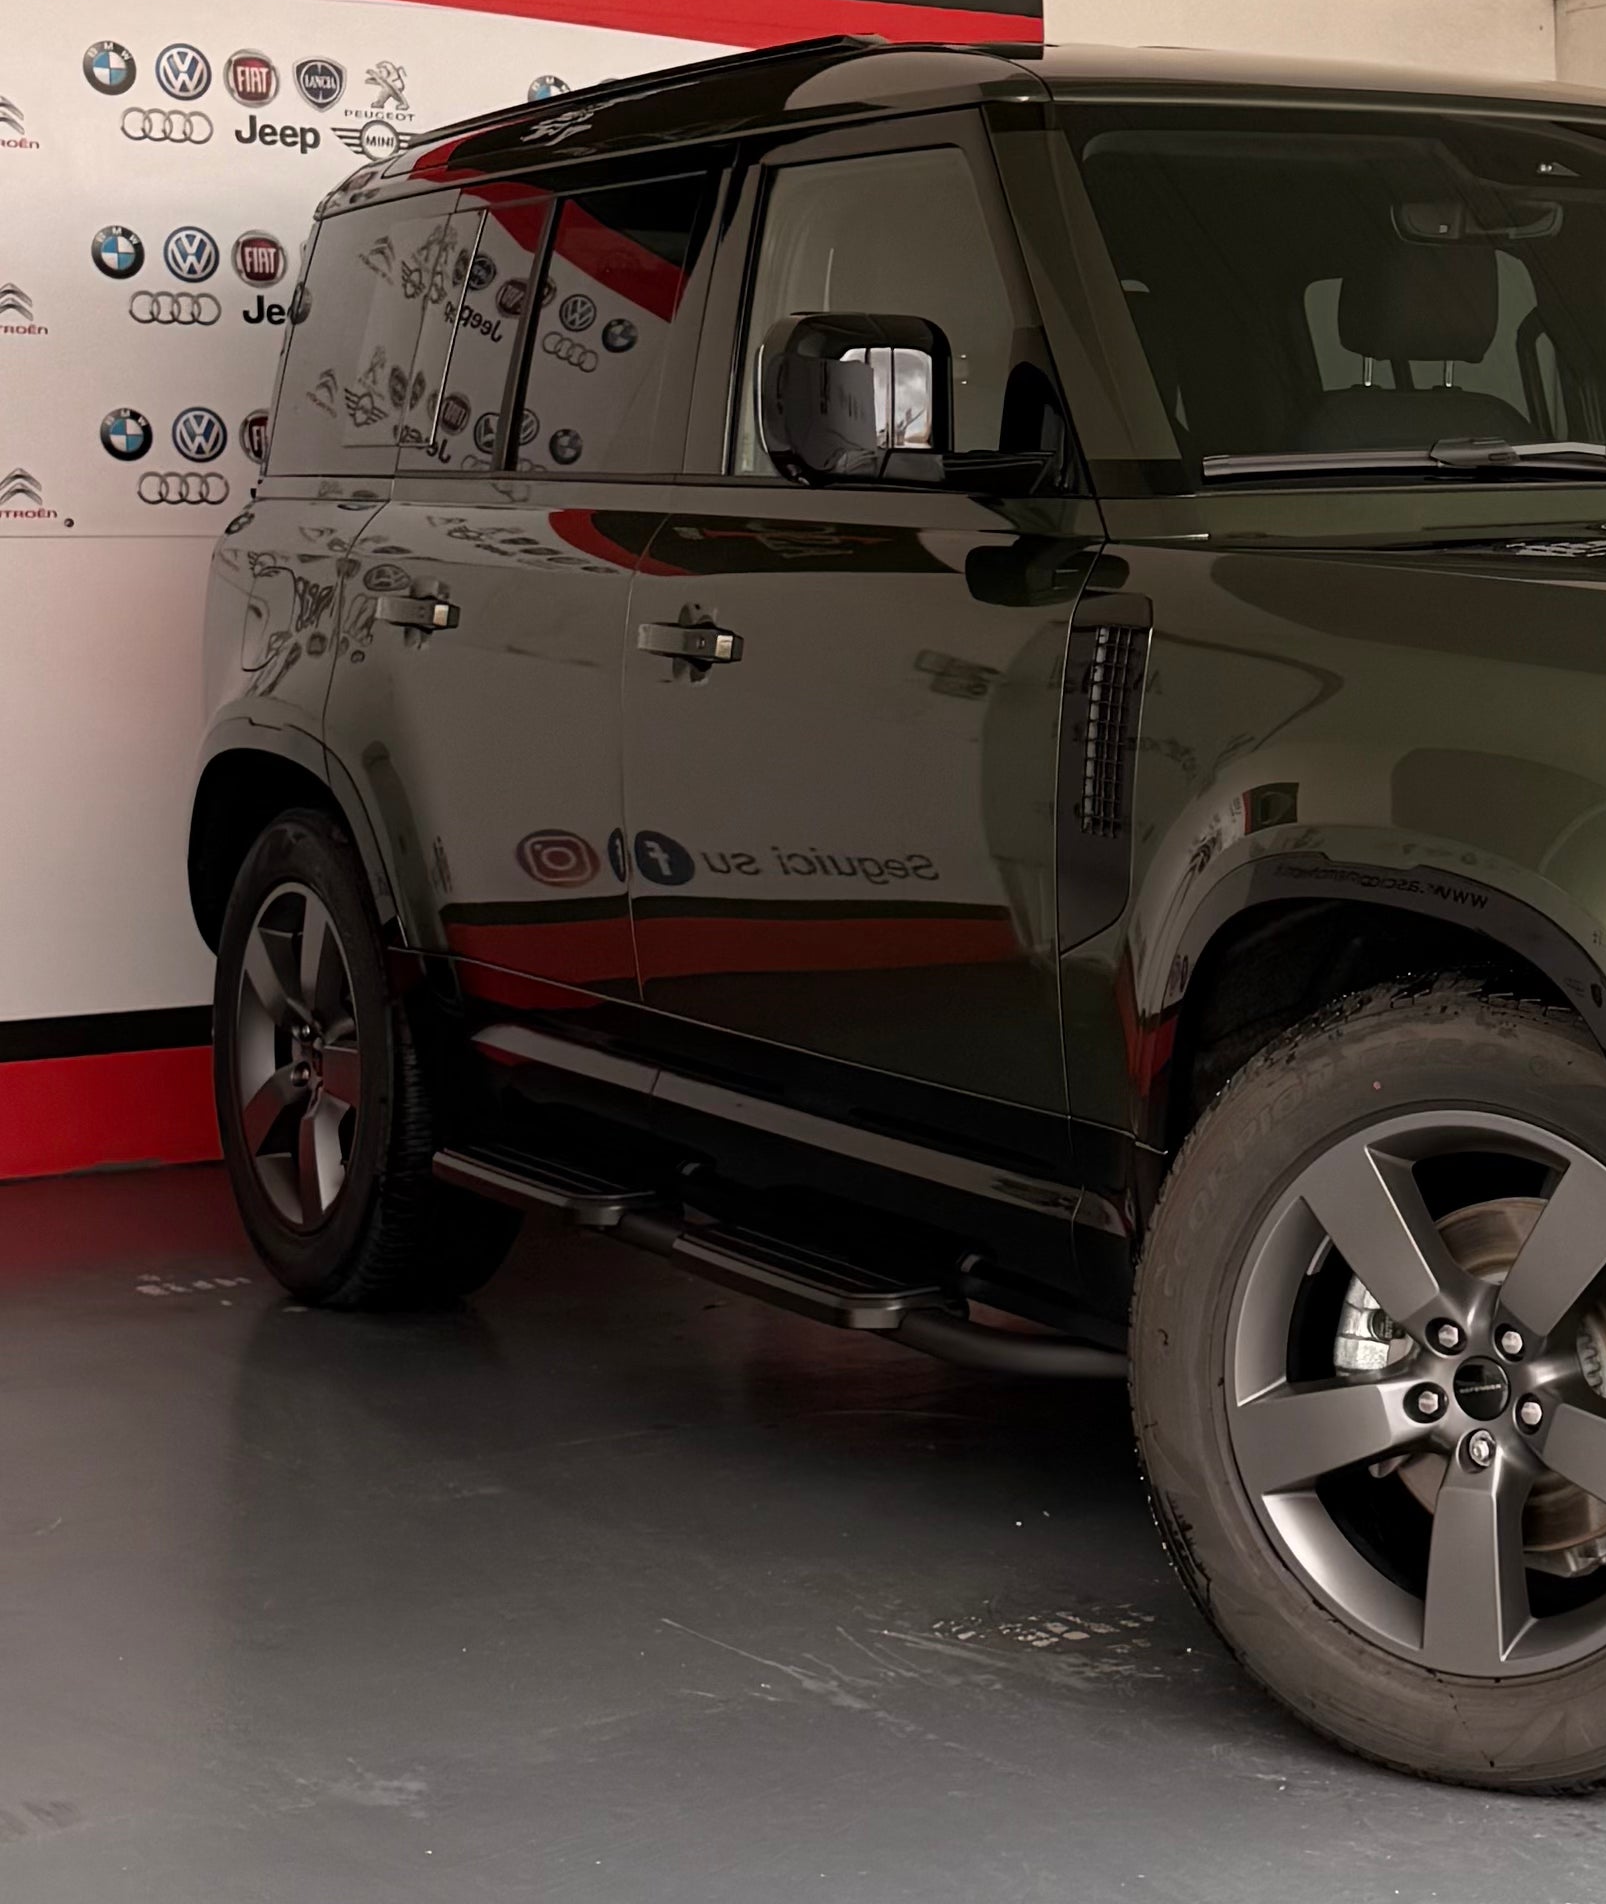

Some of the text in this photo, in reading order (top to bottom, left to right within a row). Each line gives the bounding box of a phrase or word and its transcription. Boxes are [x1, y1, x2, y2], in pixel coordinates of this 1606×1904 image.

[236, 66, 270, 94] FIAT
[344, 109, 416, 122] PEUGEOT
[235, 114, 321, 154] Jeep
[365, 135, 395, 149] MINI
[244, 247, 277, 275] FIAT
